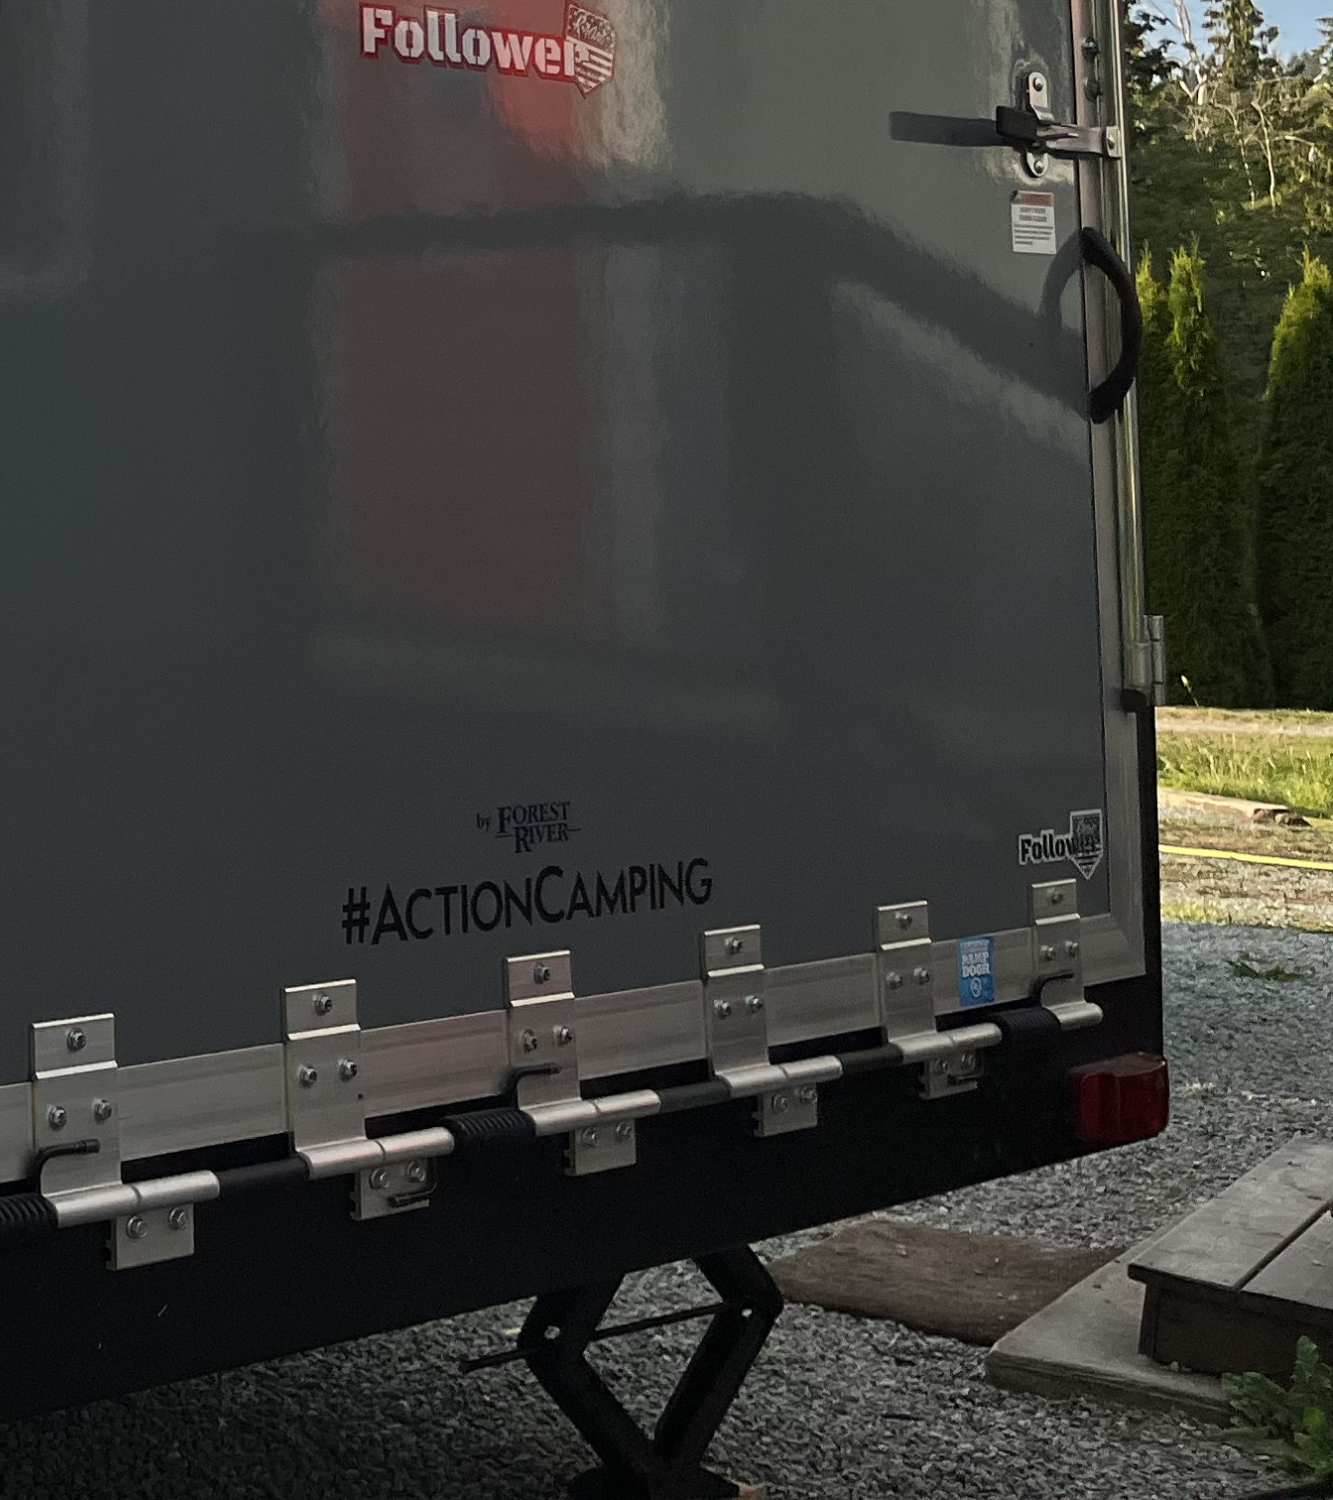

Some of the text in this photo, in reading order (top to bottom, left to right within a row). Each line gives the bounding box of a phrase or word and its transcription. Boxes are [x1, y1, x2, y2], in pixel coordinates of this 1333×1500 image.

[361, 6, 590, 77] Follower
[476, 801, 570, 833] by FOREST
[513, 823, 569, 853] RIVER
[962, 963, 990, 977] DOOR
